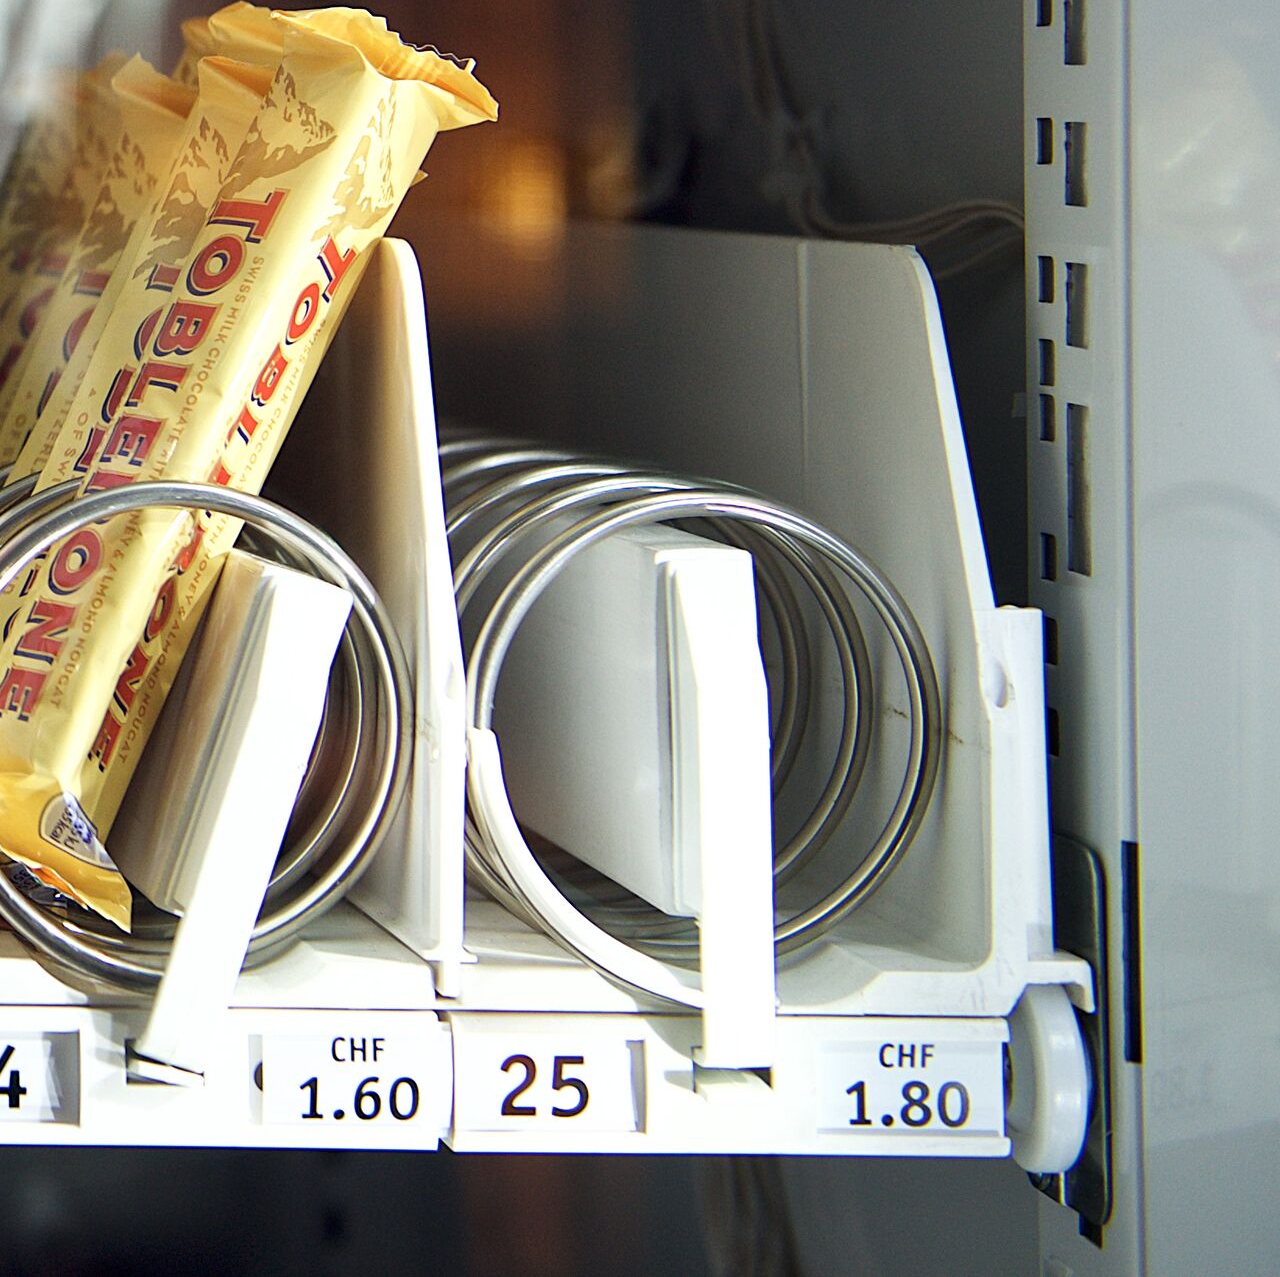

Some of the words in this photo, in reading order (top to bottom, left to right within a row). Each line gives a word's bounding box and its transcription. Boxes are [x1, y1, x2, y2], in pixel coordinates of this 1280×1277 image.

[234, 255, 265, 304] SWISS
[213, 306, 240, 344] MILK
[167, 346, 221, 447] CHOCOLATE
[237, 408, 282, 490] CHOCOLA
[120, 509, 143, 547] NEY
[81, 562, 118, 633] ALMOND
[50, 636, 86, 710] NOUGAT
[146, 619, 181, 690] ALMOND
[118, 693, 152, 764] NOUGAT
[331, 1036, 385, 1063] CHF
[878, 1043, 935, 1069] CHF
[299, 1076, 421, 1121] 1.60
[500, 1054, 590, 1118] 25
[845, 1080, 970, 1128] 1.80
